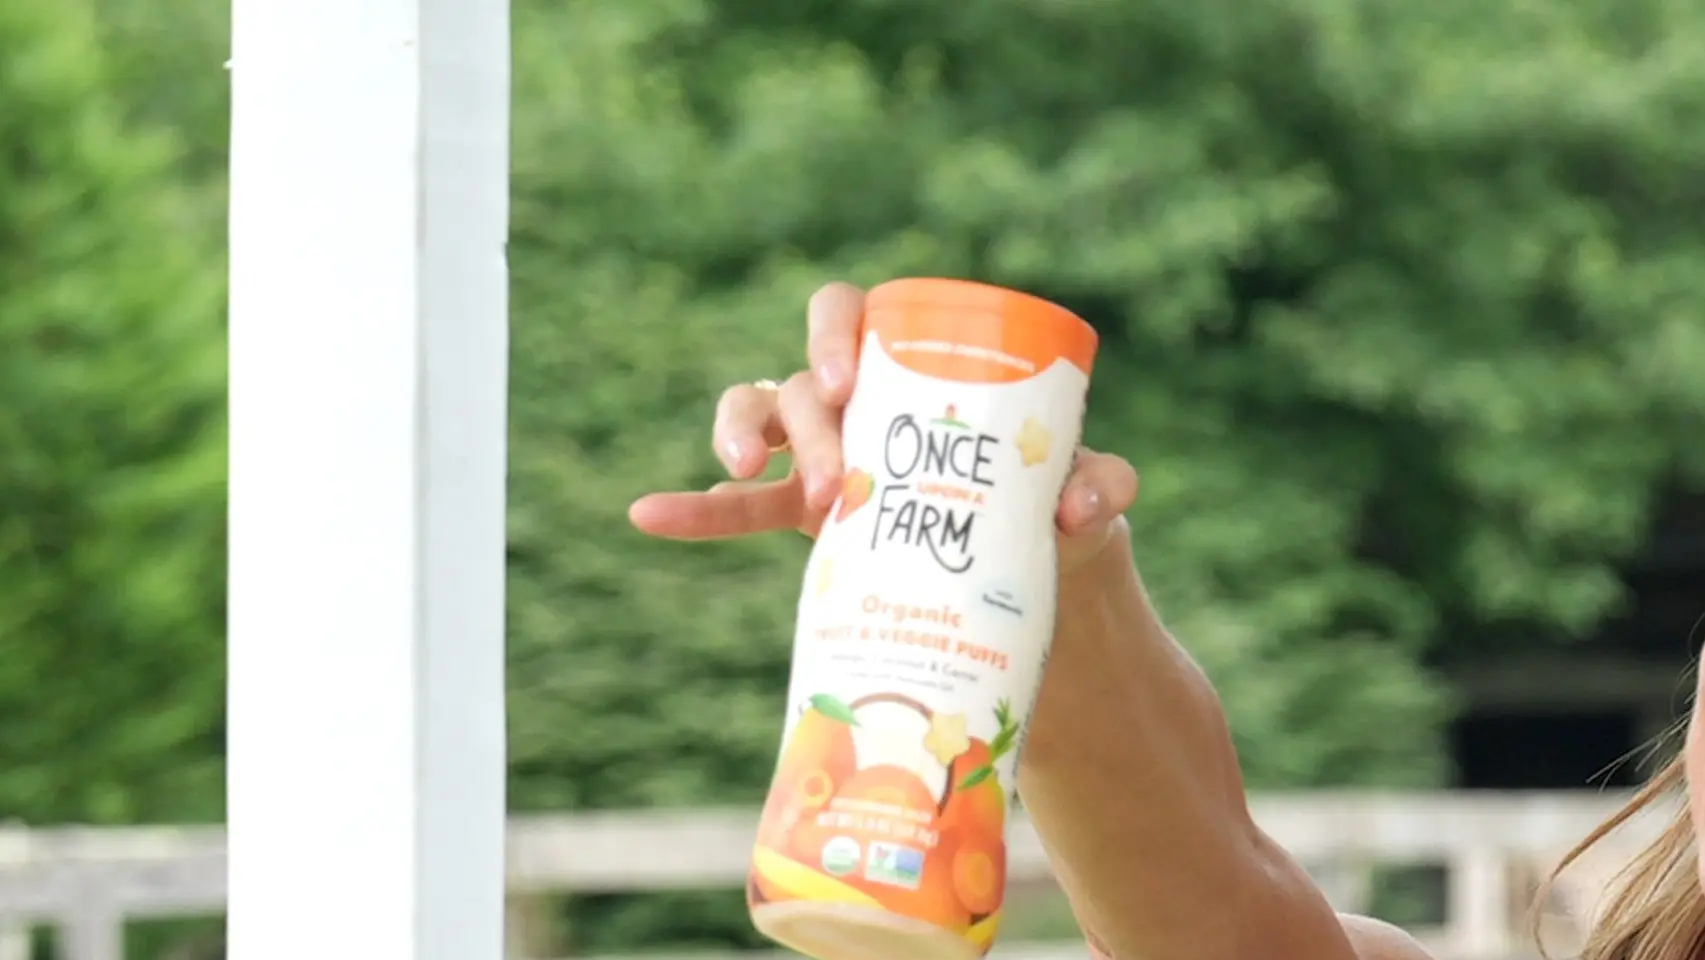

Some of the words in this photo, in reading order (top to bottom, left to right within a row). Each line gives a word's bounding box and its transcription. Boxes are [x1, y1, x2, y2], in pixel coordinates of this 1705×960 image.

[885, 414, 999, 487] ONCE
[872, 485, 975, 573] FARM
[861, 594, 963, 628] Organic
